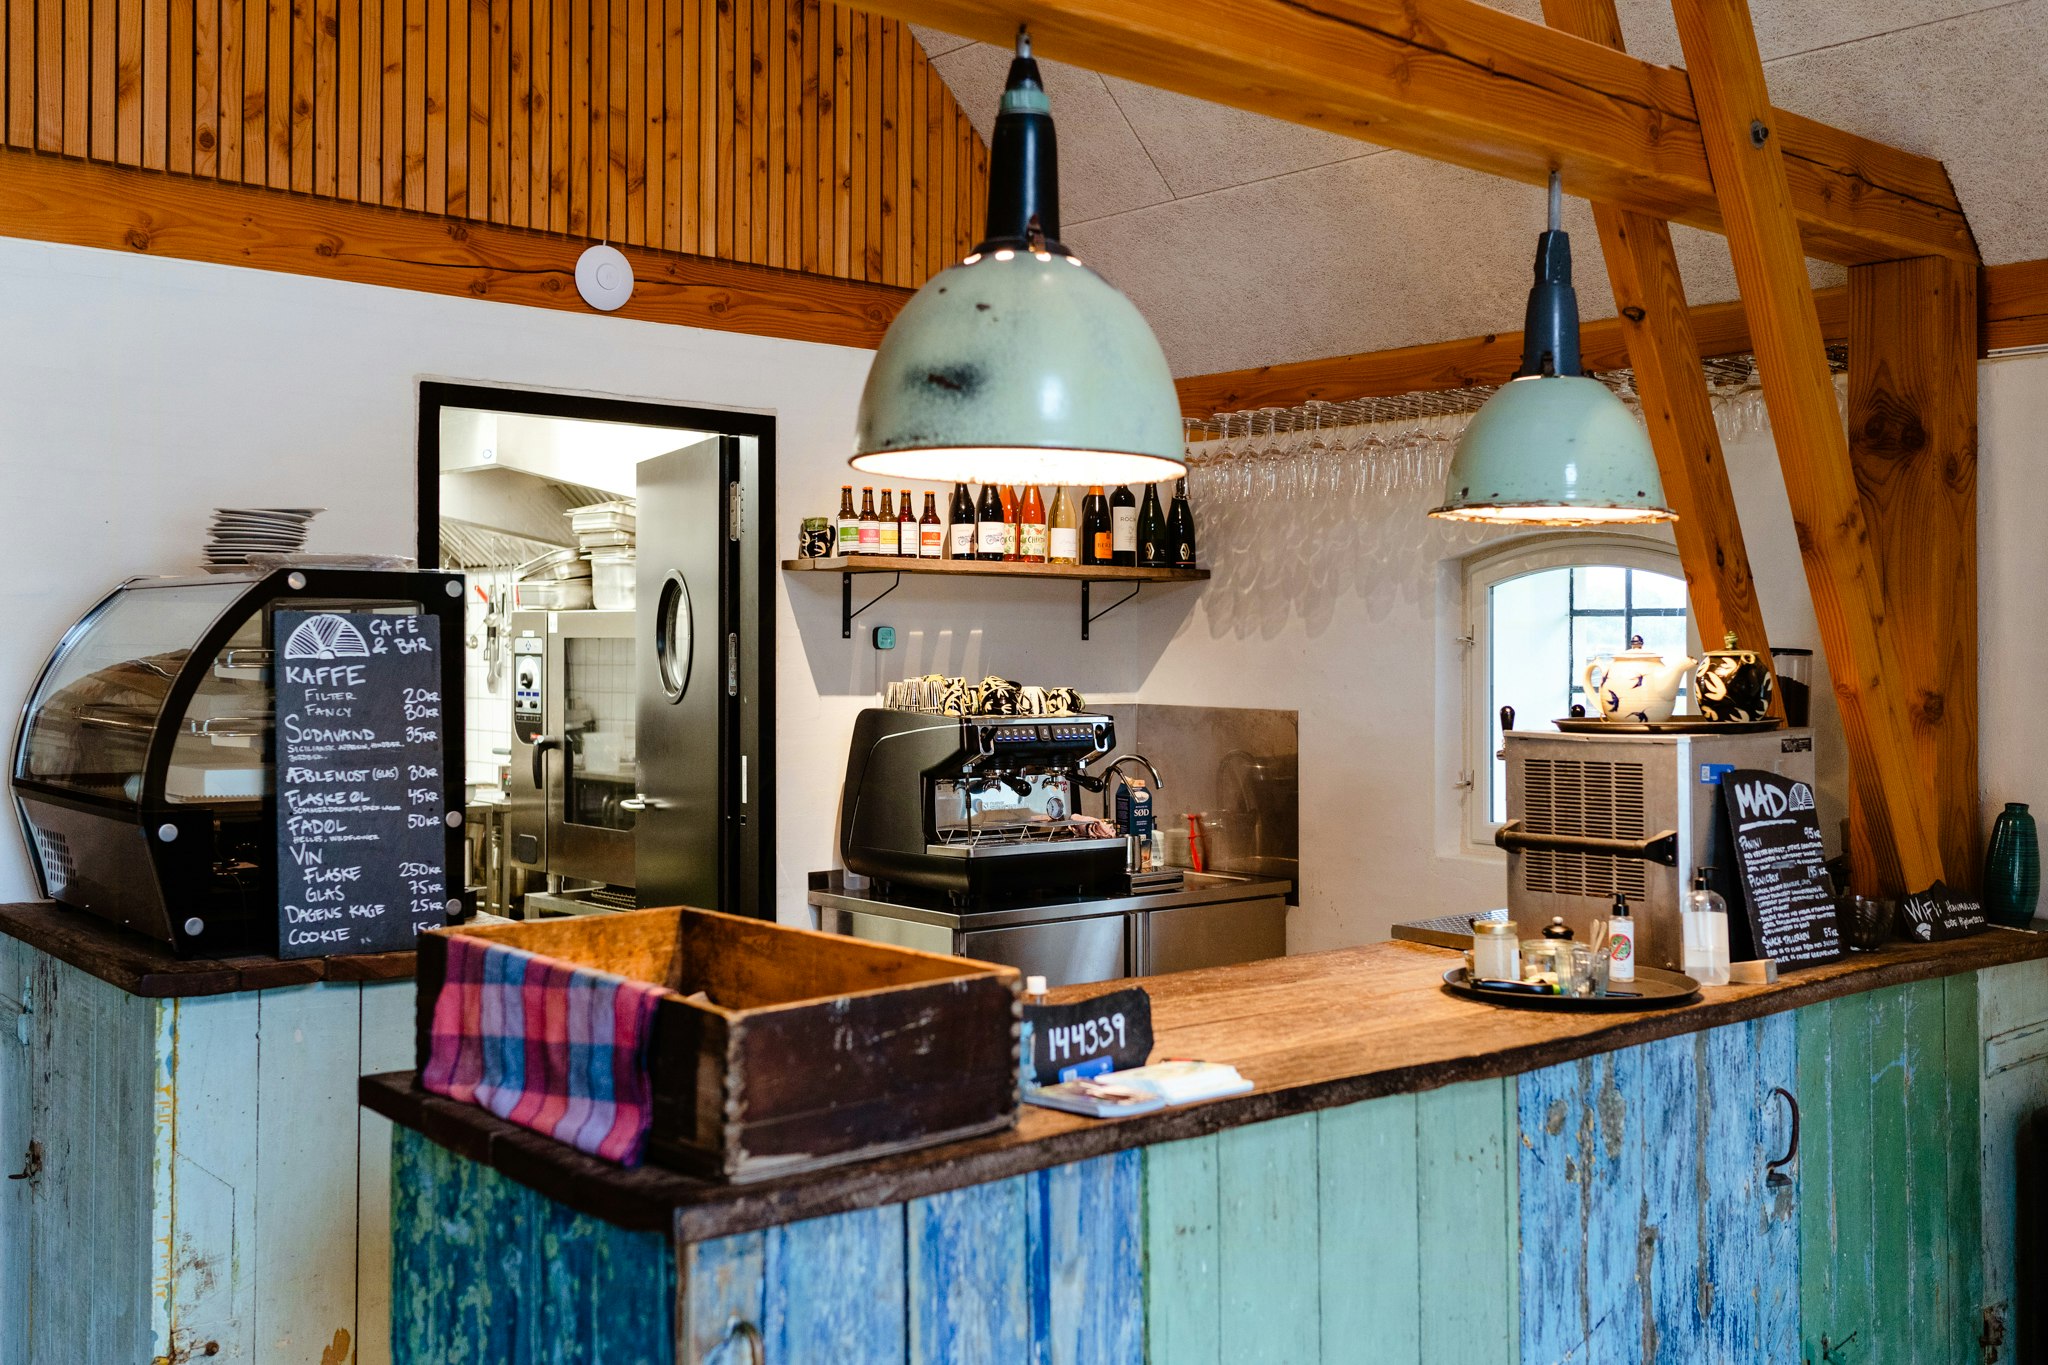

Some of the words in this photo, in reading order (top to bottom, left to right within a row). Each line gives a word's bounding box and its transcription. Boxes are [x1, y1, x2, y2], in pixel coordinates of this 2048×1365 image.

[372, 638, 388, 654] &
[394, 638, 432, 654] BAR
[286, 665, 366, 686] KAFFE
[305, 688, 357, 701] FILTER
[403, 688, 440, 704] 20KR
[305, 704, 351, 717] FANCY
[404, 704, 439, 720] 30KR
[285, 714, 375, 743] SODAVAND
[406, 727, 438, 743] 35KR
[286, 767, 371, 783] ÆBLEMOST
[408, 765, 438, 781] 30KR
[285, 790, 346, 808] FLASKE
[349, 791, 371, 803] ØL
[408, 788, 439, 805] 45KR
[1734, 780, 1788, 819] MAD
[1134, 808, 1149, 817] SØD
[287, 816, 347, 836] FADØL
[408, 814, 441, 829] 50KR
[289, 843, 322, 865] VIN
[303, 865, 362, 884] FLASKE
[398, 862, 442, 877] 250KR
[305, 885, 345, 902] GLAS
[408, 880, 444, 895] 75KR
[284, 905, 343, 924] DAGENS
[349, 904, 385, 918] KAGE
[411, 899, 444, 913] 25KR
[288, 928, 350, 945] COOKIE
[1048, 1012, 1125, 1063] 144339
